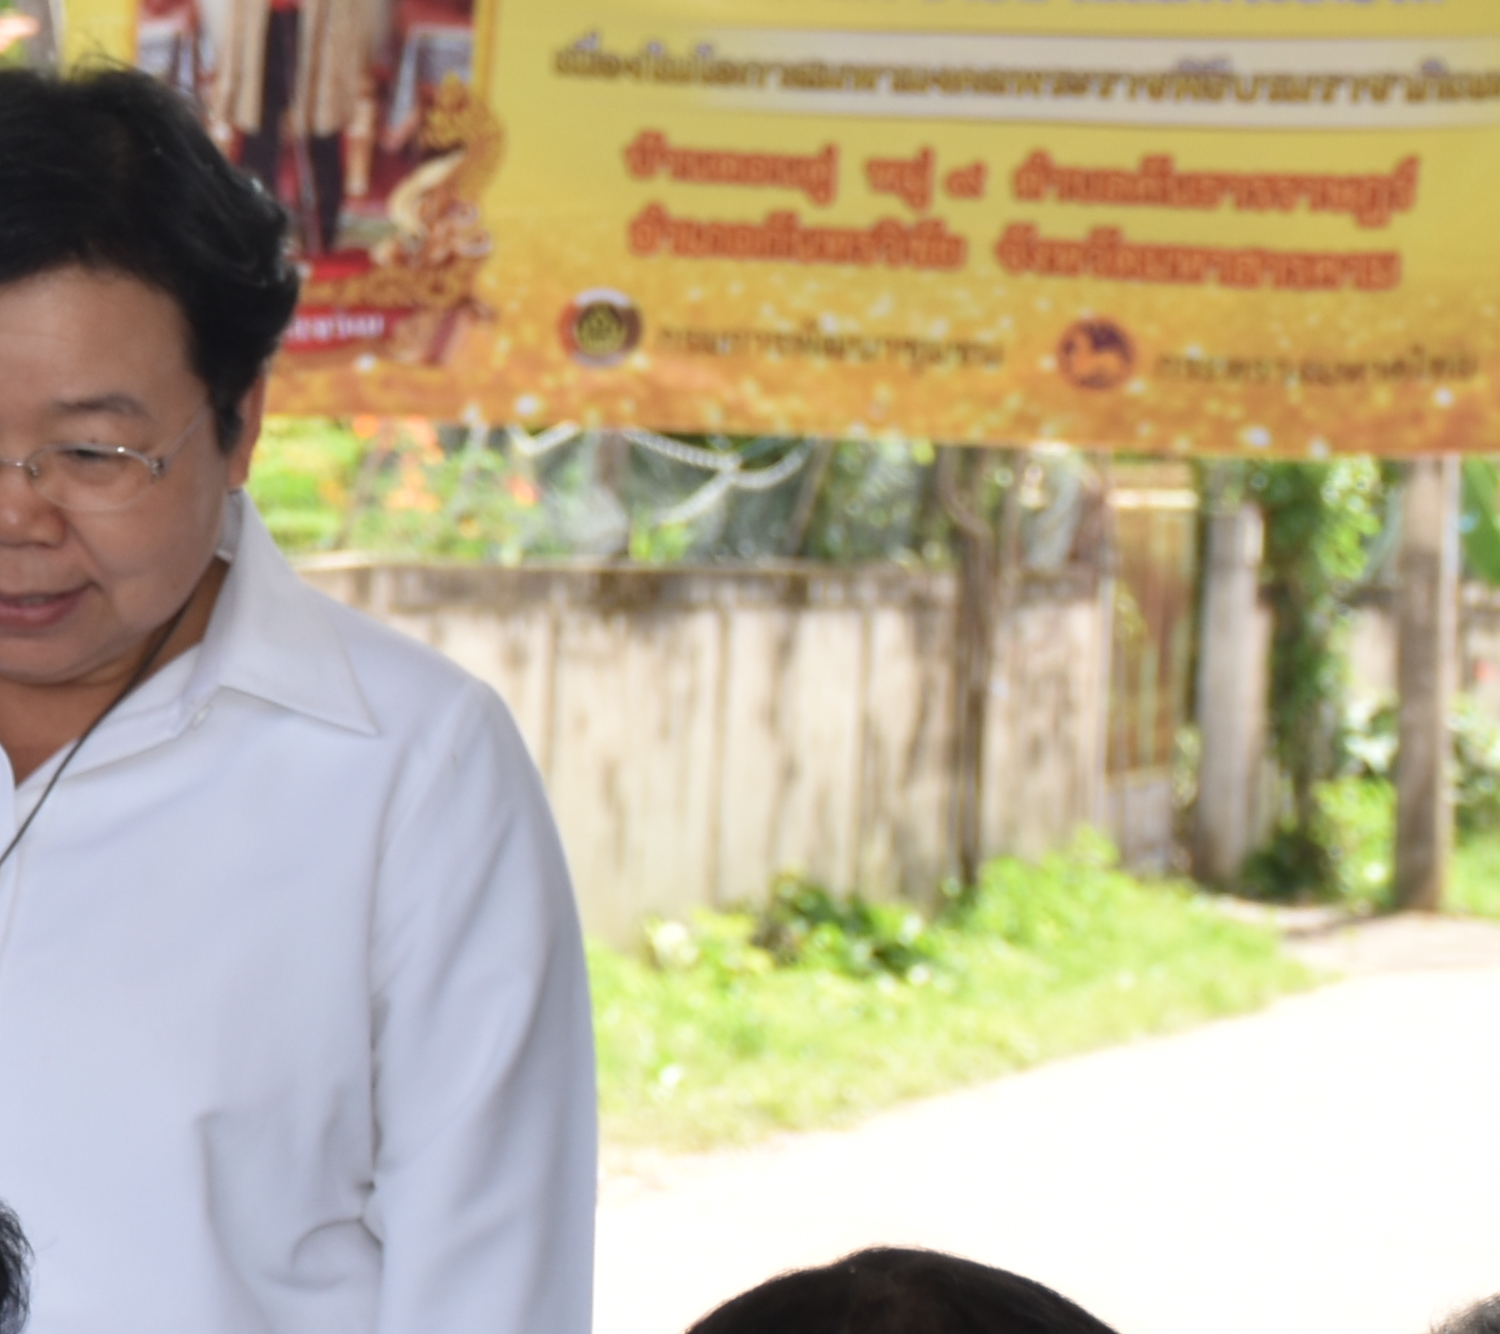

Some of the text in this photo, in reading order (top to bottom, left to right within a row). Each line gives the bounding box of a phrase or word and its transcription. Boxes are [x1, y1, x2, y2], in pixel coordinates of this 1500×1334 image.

[861, 143, 936, 211] หมู่
[1010, 148, 1422, 230] ตำบลคันธารราษฎร์
[626, 201, 1403, 291] อำเภอกันทรวิชัย จังหวัดมหาสารคาม
